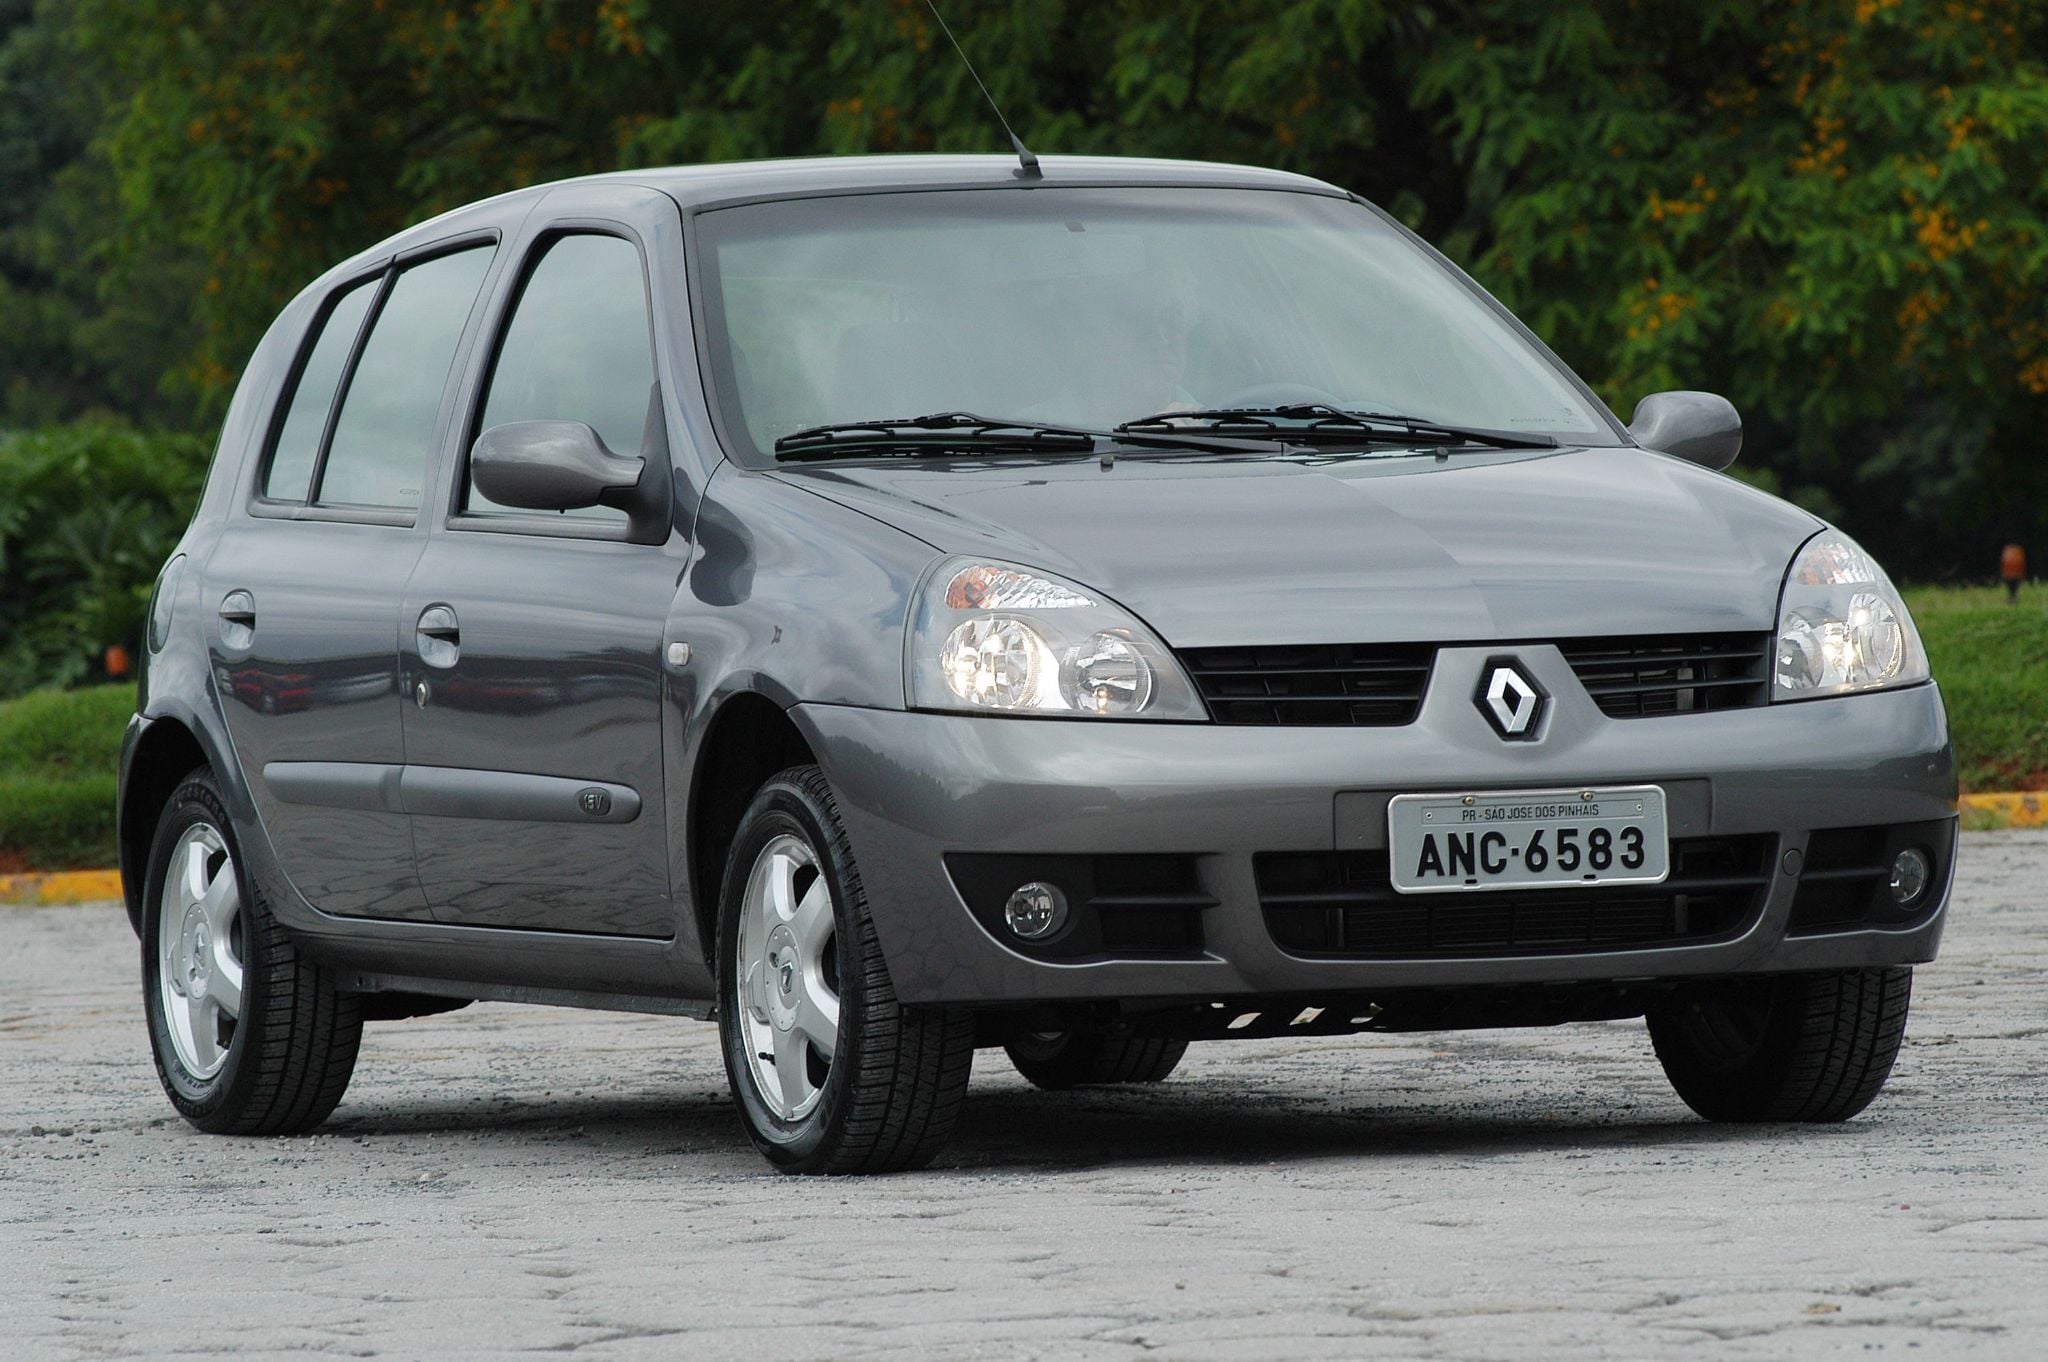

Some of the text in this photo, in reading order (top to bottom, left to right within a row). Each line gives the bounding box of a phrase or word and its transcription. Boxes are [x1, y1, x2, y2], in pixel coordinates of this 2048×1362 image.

[583, 794, 603, 810] 16V
[1462, 809, 1476, 821] PR
[1535, 805, 1556, 817] DOS
[1558, 804, 1599, 817] PINHAIS
